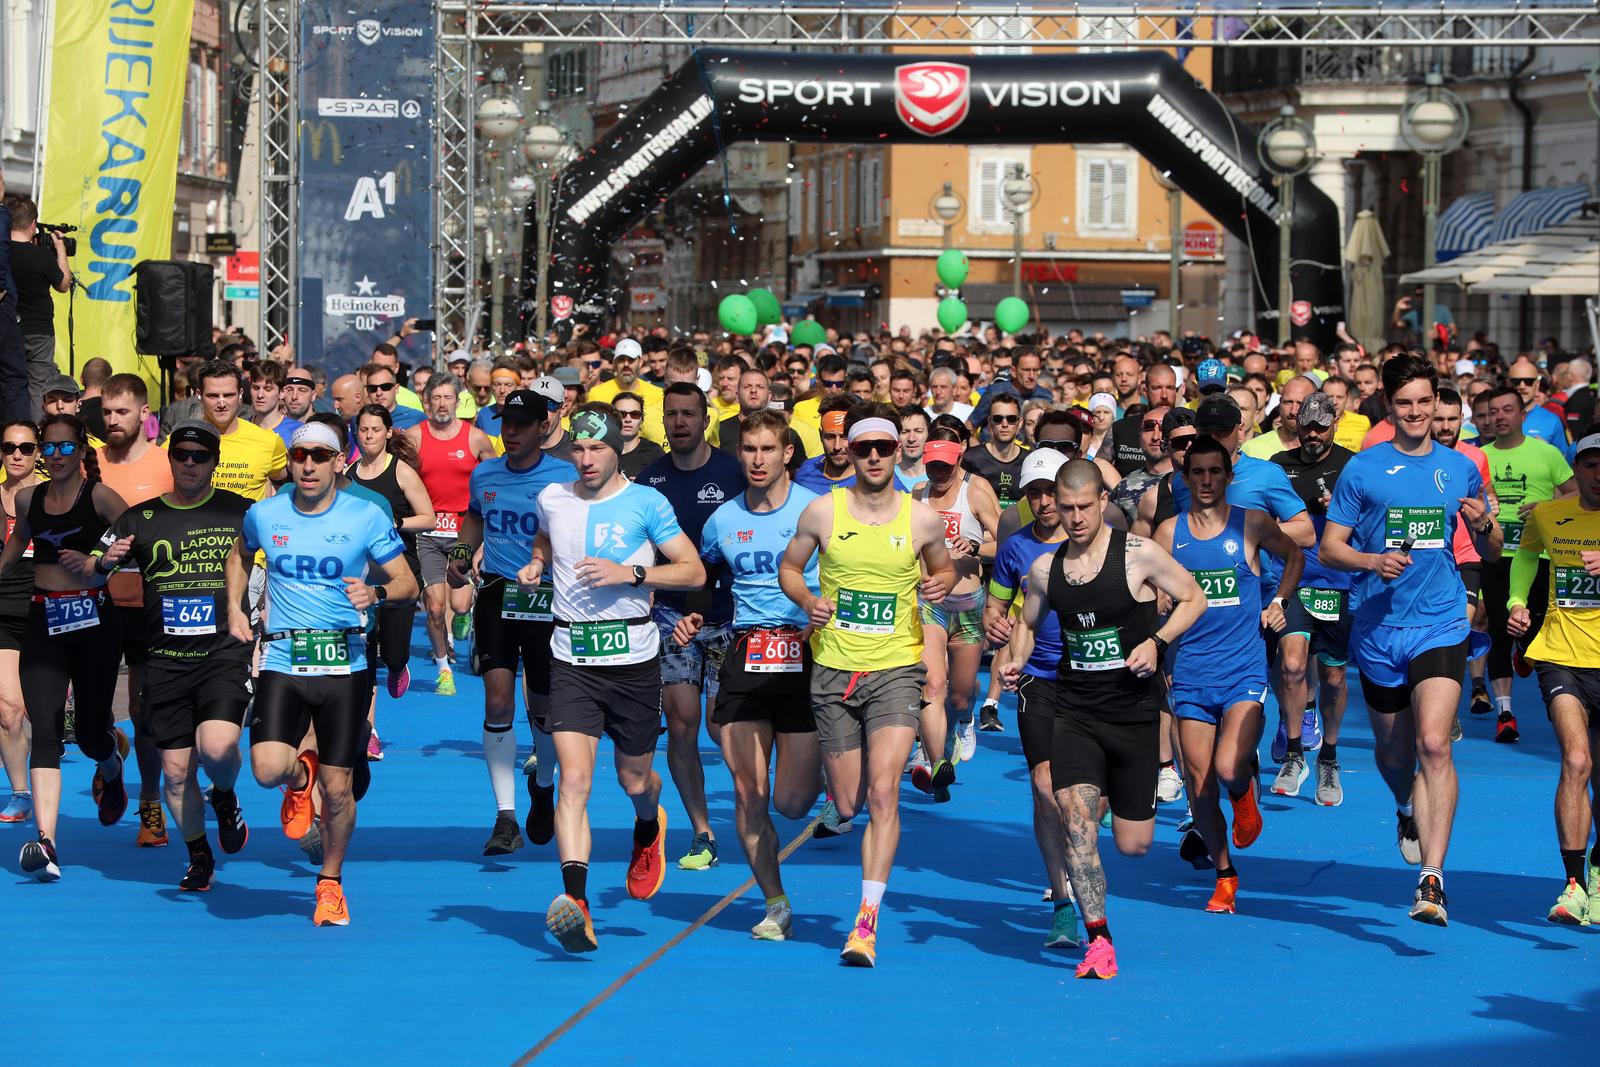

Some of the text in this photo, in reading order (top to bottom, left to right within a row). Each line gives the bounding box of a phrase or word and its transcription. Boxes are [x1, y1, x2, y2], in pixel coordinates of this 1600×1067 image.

[313, 25, 354, 34] SPORT
[738, 78, 882, 106] SPORT
[981, 80, 1120, 107] VISION
[344, 171, 395, 221] A1
[331, 299, 400, 312] Heineken
[225, 462, 249, 470] people
[650, 476, 667, 485] spin
[486, 509, 540, 536] CRO
[1408, 521, 1435, 536] 887
[1552, 536, 1582, 545] Runners
[179, 562, 224, 574] ULTRA
[275, 554, 344, 580] CRO
[1201, 576, 1236, 595] 219
[840, 594, 853, 602] RUN
[1314, 599, 1334, 611] 883
[60, 598, 94, 620] 759
[179, 604, 213, 623] 647
[856, 601, 894, 621] 316
[590, 631, 627, 652] 120
[765, 641, 801, 660] 608
[1082, 637, 1120, 658] 295
[314, 643, 348, 662] 105
